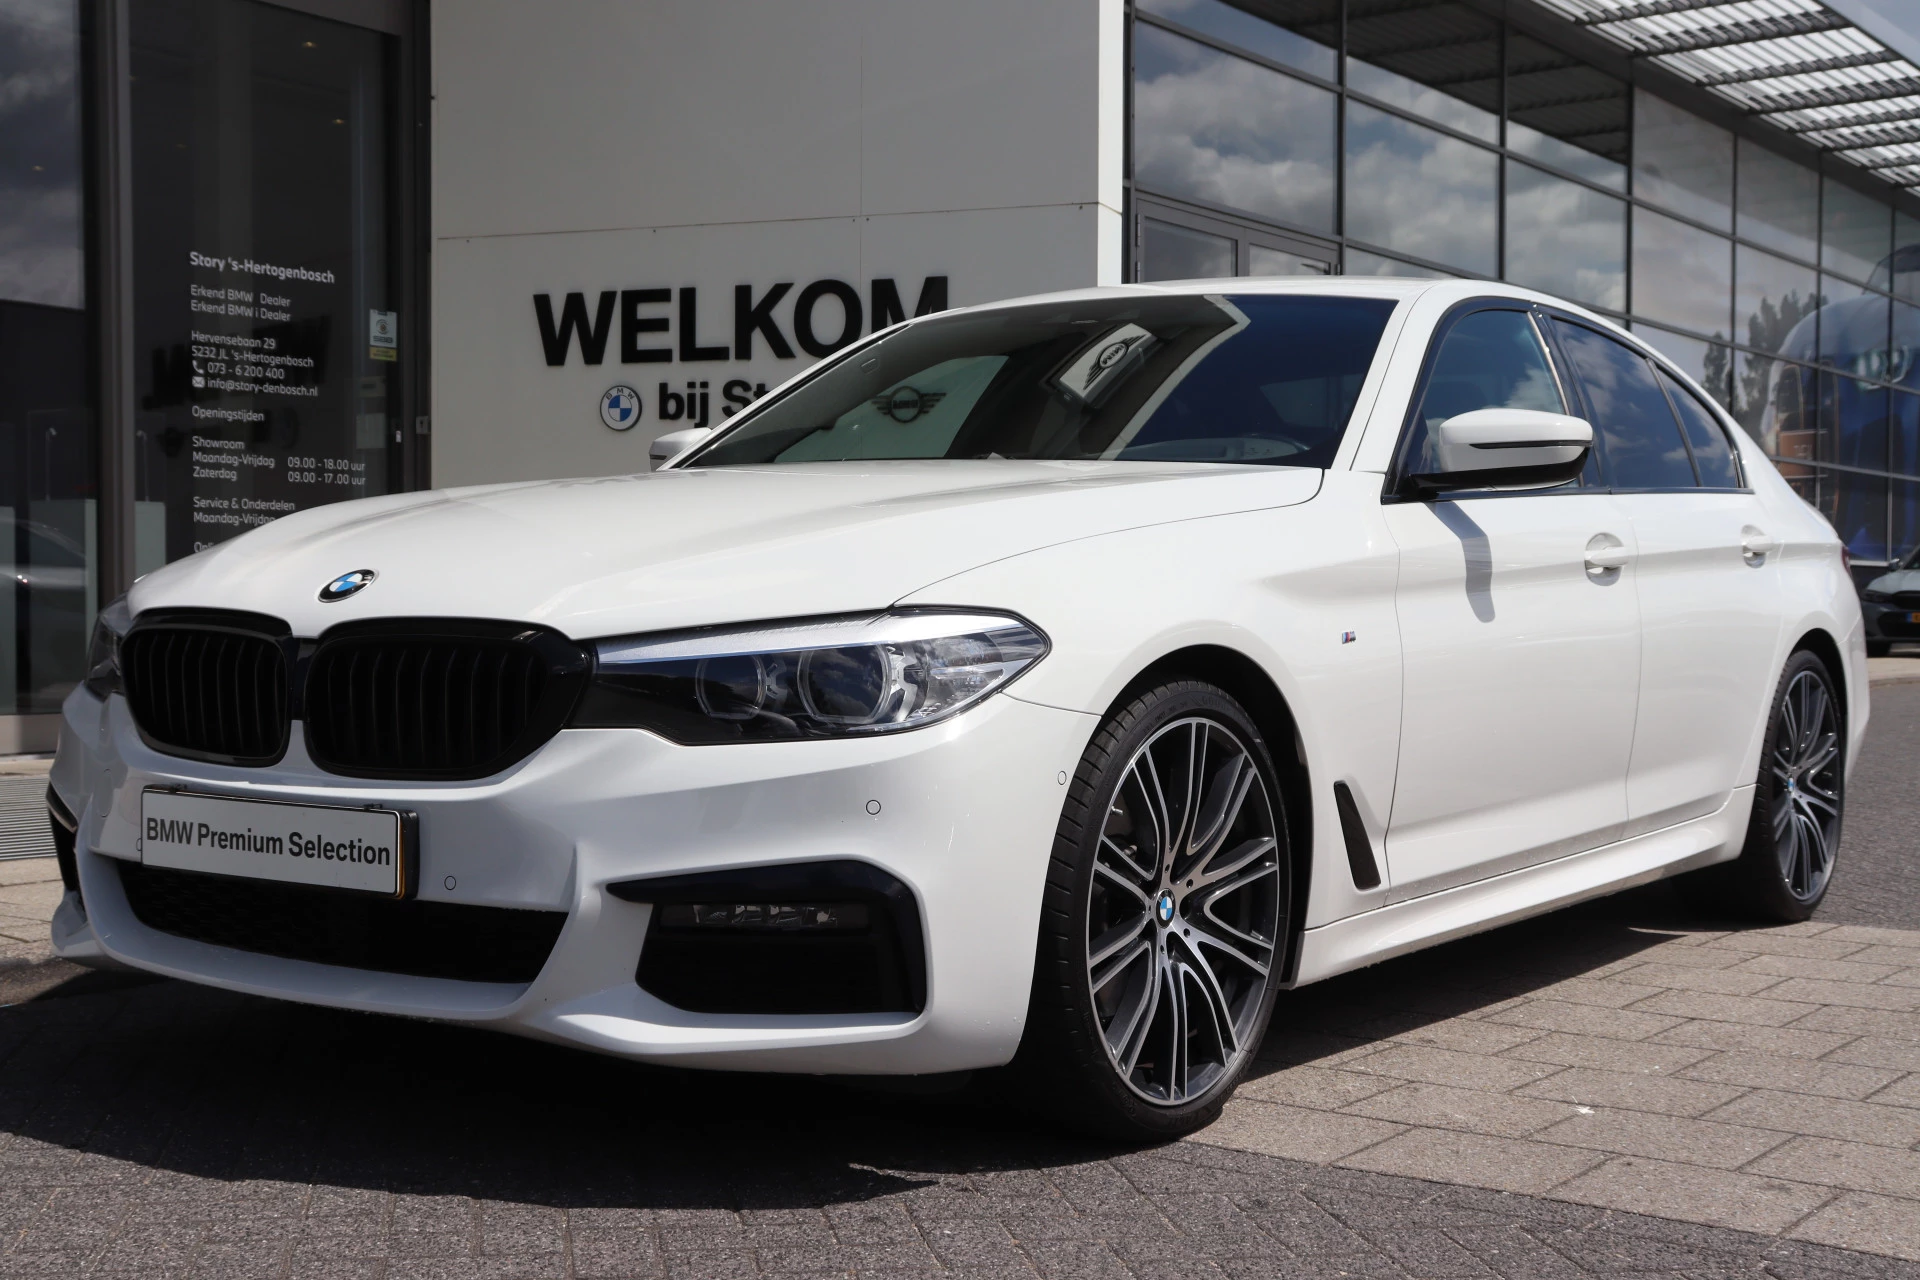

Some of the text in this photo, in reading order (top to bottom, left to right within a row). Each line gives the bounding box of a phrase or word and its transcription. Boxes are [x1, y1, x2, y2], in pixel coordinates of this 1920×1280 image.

[190, 252, 335, 284] Story 's-Hertogenbosch
[190, 285, 291, 307] Erkend BMW Dealer
[190, 300, 225, 314] Erkend
[227, 304, 253, 317] BMW
[260, 308, 291, 321] Dealer
[191, 331, 276, 349] Hervensebaan 29
[191, 346, 216, 358] 5232
[217, 348, 229, 360] JL
[207, 362, 226, 374] 073
[235, 365, 242, 376] 6
[243, 366, 263, 378] 200
[265, 367, 285, 379] 400
[208, 377, 318, 396] info@story-denbosch.nl
[658, 380, 709, 428] bij
[192, 406, 265, 422] Openingstijden
[192, 436, 245, 450] Showroom
[192, 451, 276, 469] Maandag-Vrijdag
[287, 457, 316, 468] 09.00
[324, 458, 349, 470] 18.00
[350, 462, 366, 471] uur
[193, 466, 238, 482] Zaterdag
[287, 472, 316, 484] 09.00
[351, 477, 366, 486] uur
[193, 497, 295, 511] Service & Onderdelen
[146, 817, 391, 866] BMW Premium Selection
